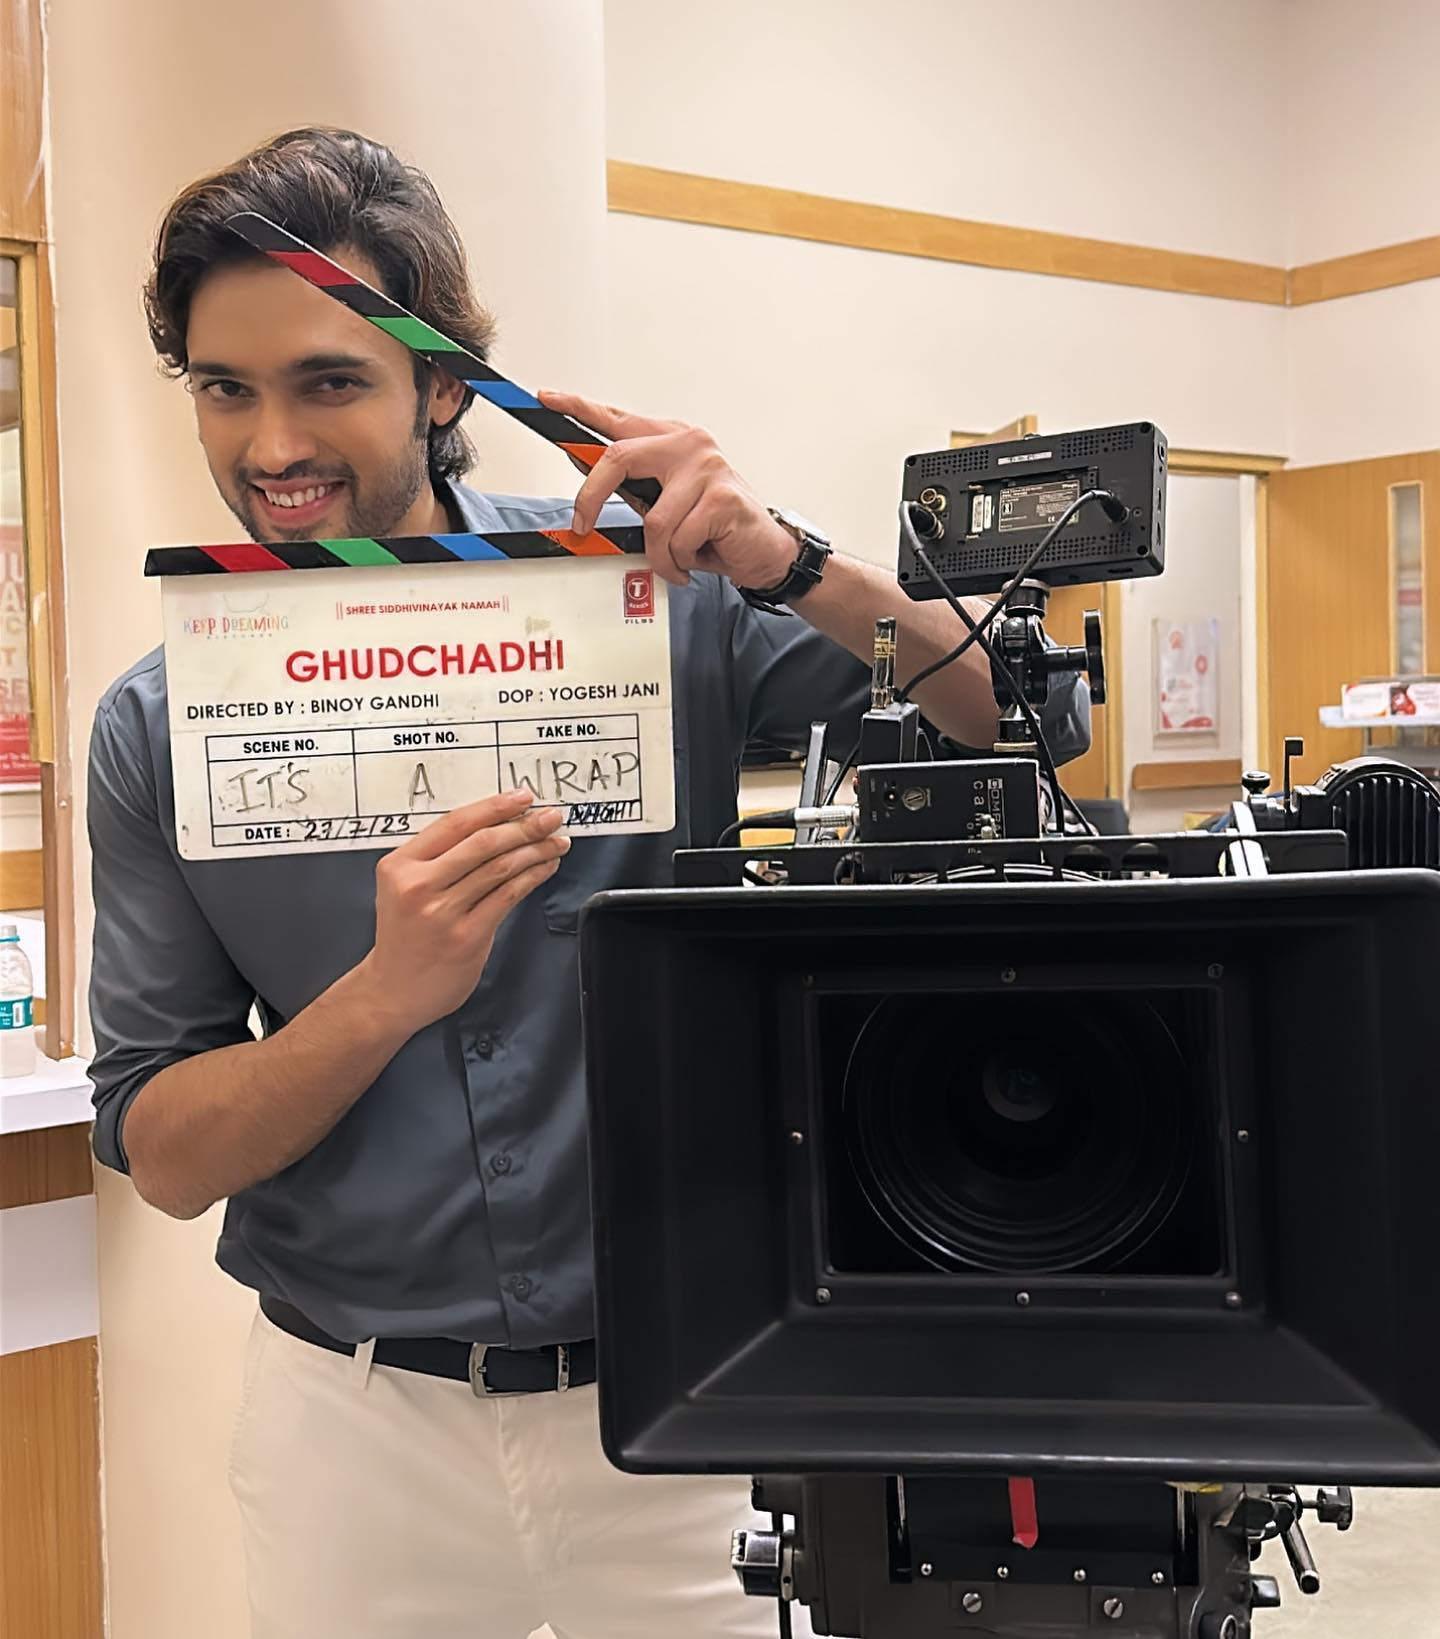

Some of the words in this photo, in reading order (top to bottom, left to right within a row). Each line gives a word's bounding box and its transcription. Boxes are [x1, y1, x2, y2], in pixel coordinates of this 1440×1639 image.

[345, 605, 376, 615] SHREE
[379, 602, 458, 614] SIDDHIVINAYAK
[461, 600, 500, 610] NAMAH
[184, 616, 216, 635] KEEP
[223, 615, 289, 633] DREAMING
[286, 639, 565, 683] GHUDCHADHI
[498, 689, 534, 704] DOP
[549, 685, 617, 701] YOGESH
[623, 682, 660, 698] JANI
[187, 702, 269, 720] DIRECTED
[274, 700, 295, 716] BY
[311, 697, 364, 714] BINOY
[370, 694, 440, 711] GANDHI
[393, 733, 430, 746] SHOT
[435, 730, 460, 744] NO.
[537, 725, 572, 738] TAKE
[576, 723, 600, 736] NO.
[243, 741, 290, 755] SCENE
[295, 738, 319, 751] NO.
[409, 762, 436, 811] A
[509, 751, 639, 801] WRAP
[244, 826, 282, 840] DATE
